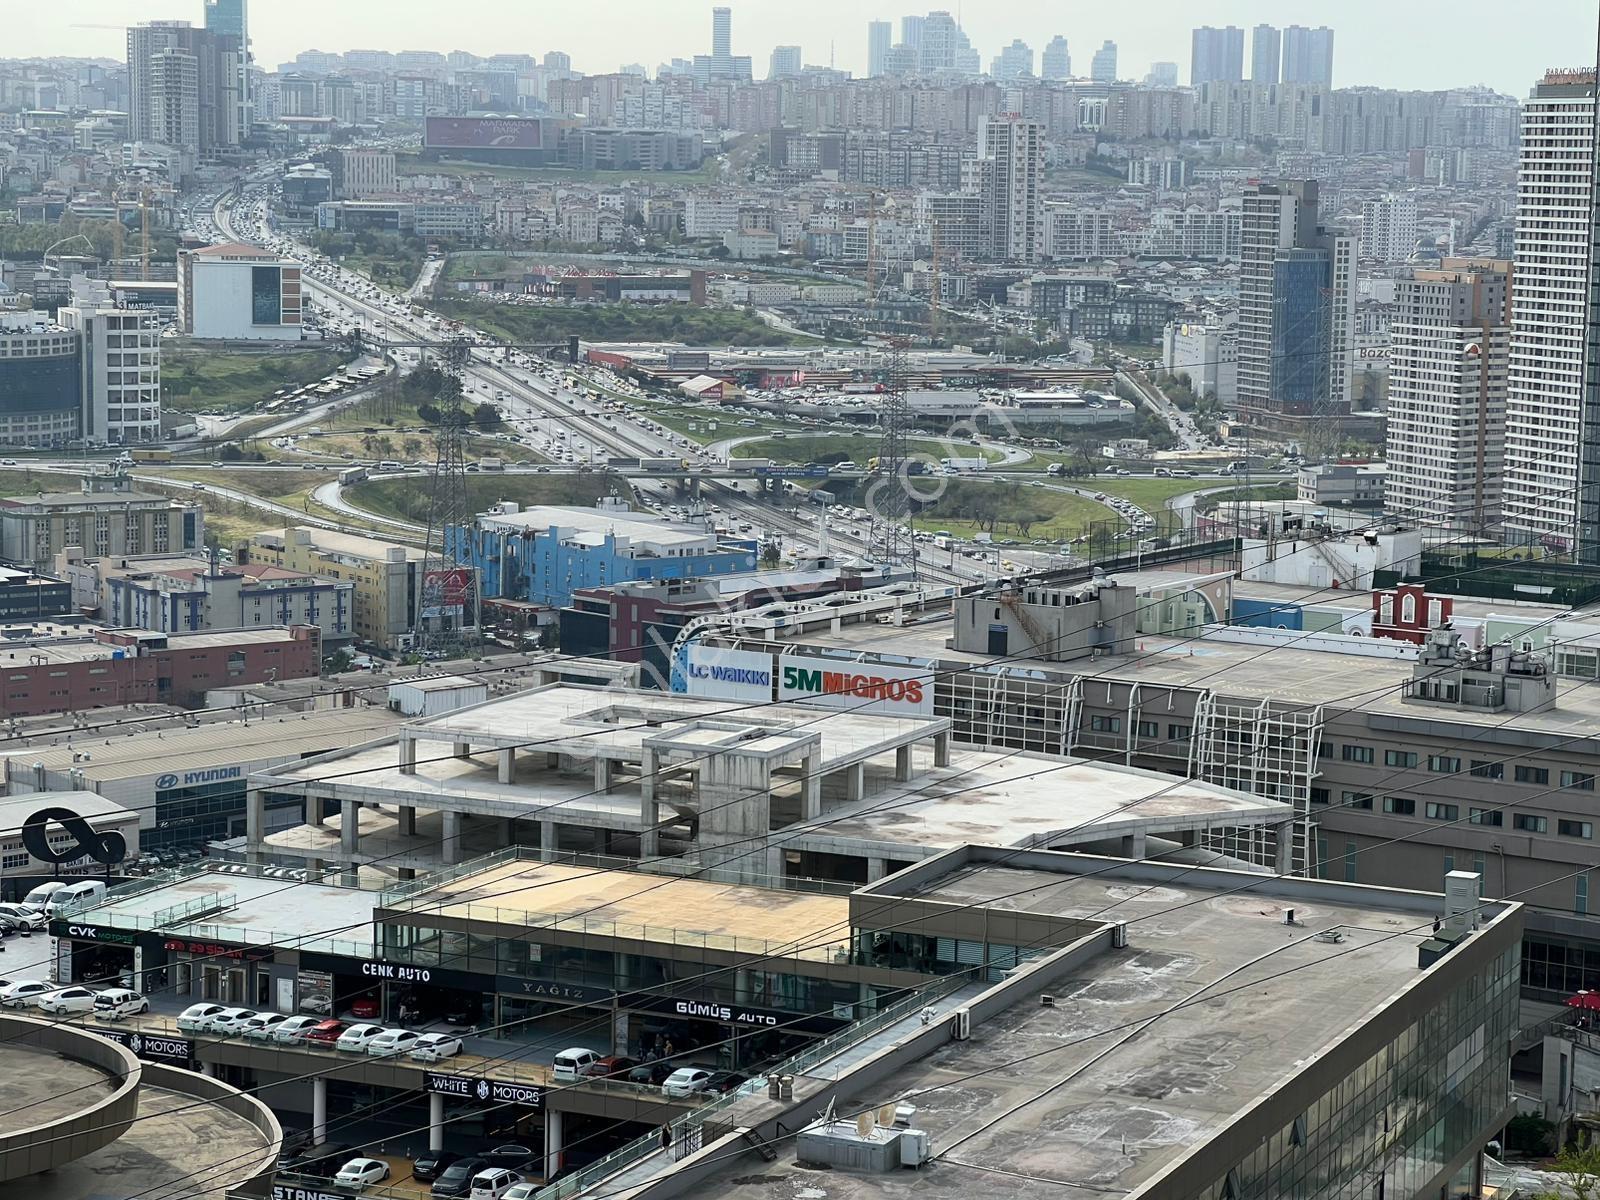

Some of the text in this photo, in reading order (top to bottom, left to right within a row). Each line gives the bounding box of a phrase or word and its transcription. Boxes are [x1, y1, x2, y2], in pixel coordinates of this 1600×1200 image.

[688, 662, 710, 680] LC
[184, 766, 241, 785] HYUNDAI
[68, 926, 97, 938] CVK
[362, 963, 431, 982] CENK AUTO
[523, 982, 583, 999] YAĞIZ
[676, 1000, 777, 1025] GÜMÜŞ AUTO
[145, 1040, 188, 1056] MOTORS
[432, 1078, 540, 1103] WHITE MOTORS
